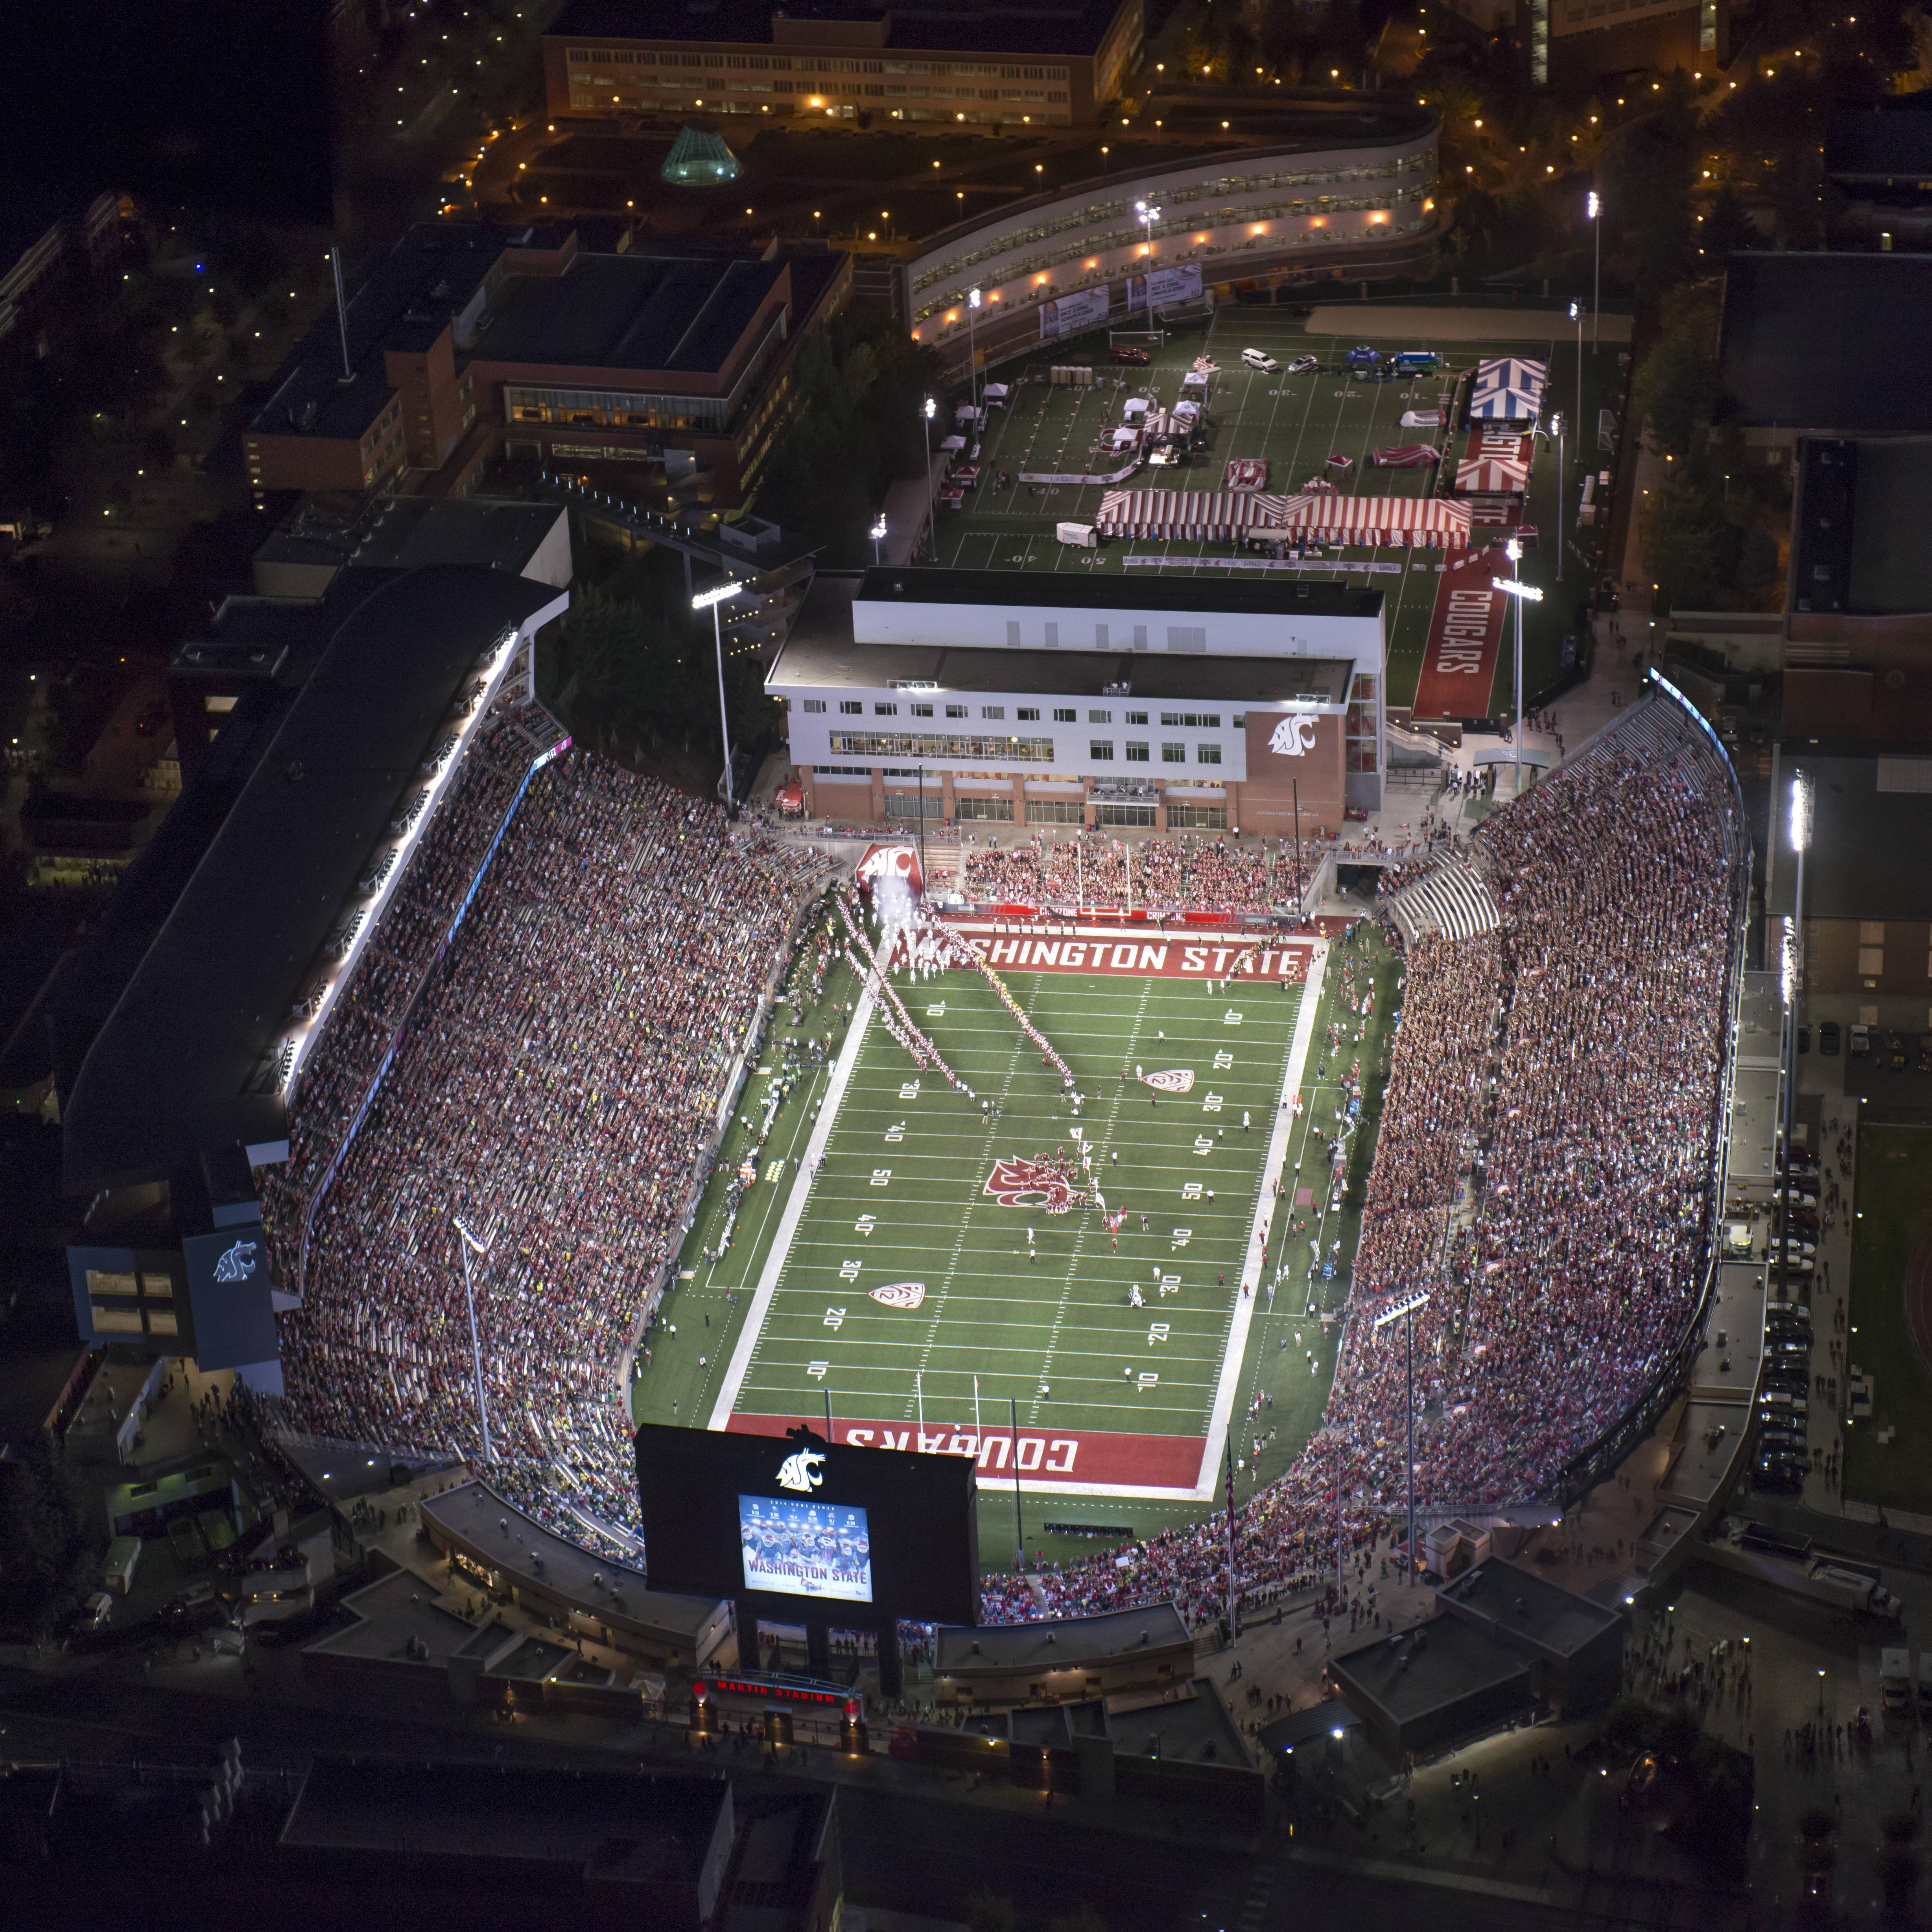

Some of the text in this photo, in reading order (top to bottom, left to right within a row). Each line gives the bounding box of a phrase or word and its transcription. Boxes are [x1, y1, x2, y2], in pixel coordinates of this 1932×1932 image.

[1436, 590, 1493, 673] COUGARS
[1182, 947, 1302, 975] STATE
[926, 1004, 946, 1016] 10
[1224, 1013, 1243, 1025] 10
[1213, 1054, 1233, 1070] 20
[899, 1083, 920, 1099] 30
[1203, 1095, 1223, 1112] 30
[885, 1125, 905, 1141] 40
[1193, 1139, 1213, 1156] 40
[870, 1169, 892, 1186] 50
[1182, 1183, 1203, 1200] 50
[855, 1213, 877, 1231] 40
[1171, 1228, 1192, 1246] 40
[839, 1260, 862, 1278] 30
[1160, 1275, 1181, 1293] 30
[823, 1307, 846, 1325] 20
[1148, 1323, 1170, 1342] 20
[807, 1361, 829, 1375] 10
[1137, 1372, 1159, 1387] 10
[748, 1560, 867, 1584] WASHINGTON STATE
[717, 1680, 834, 1703] MARTIN STADIUM
